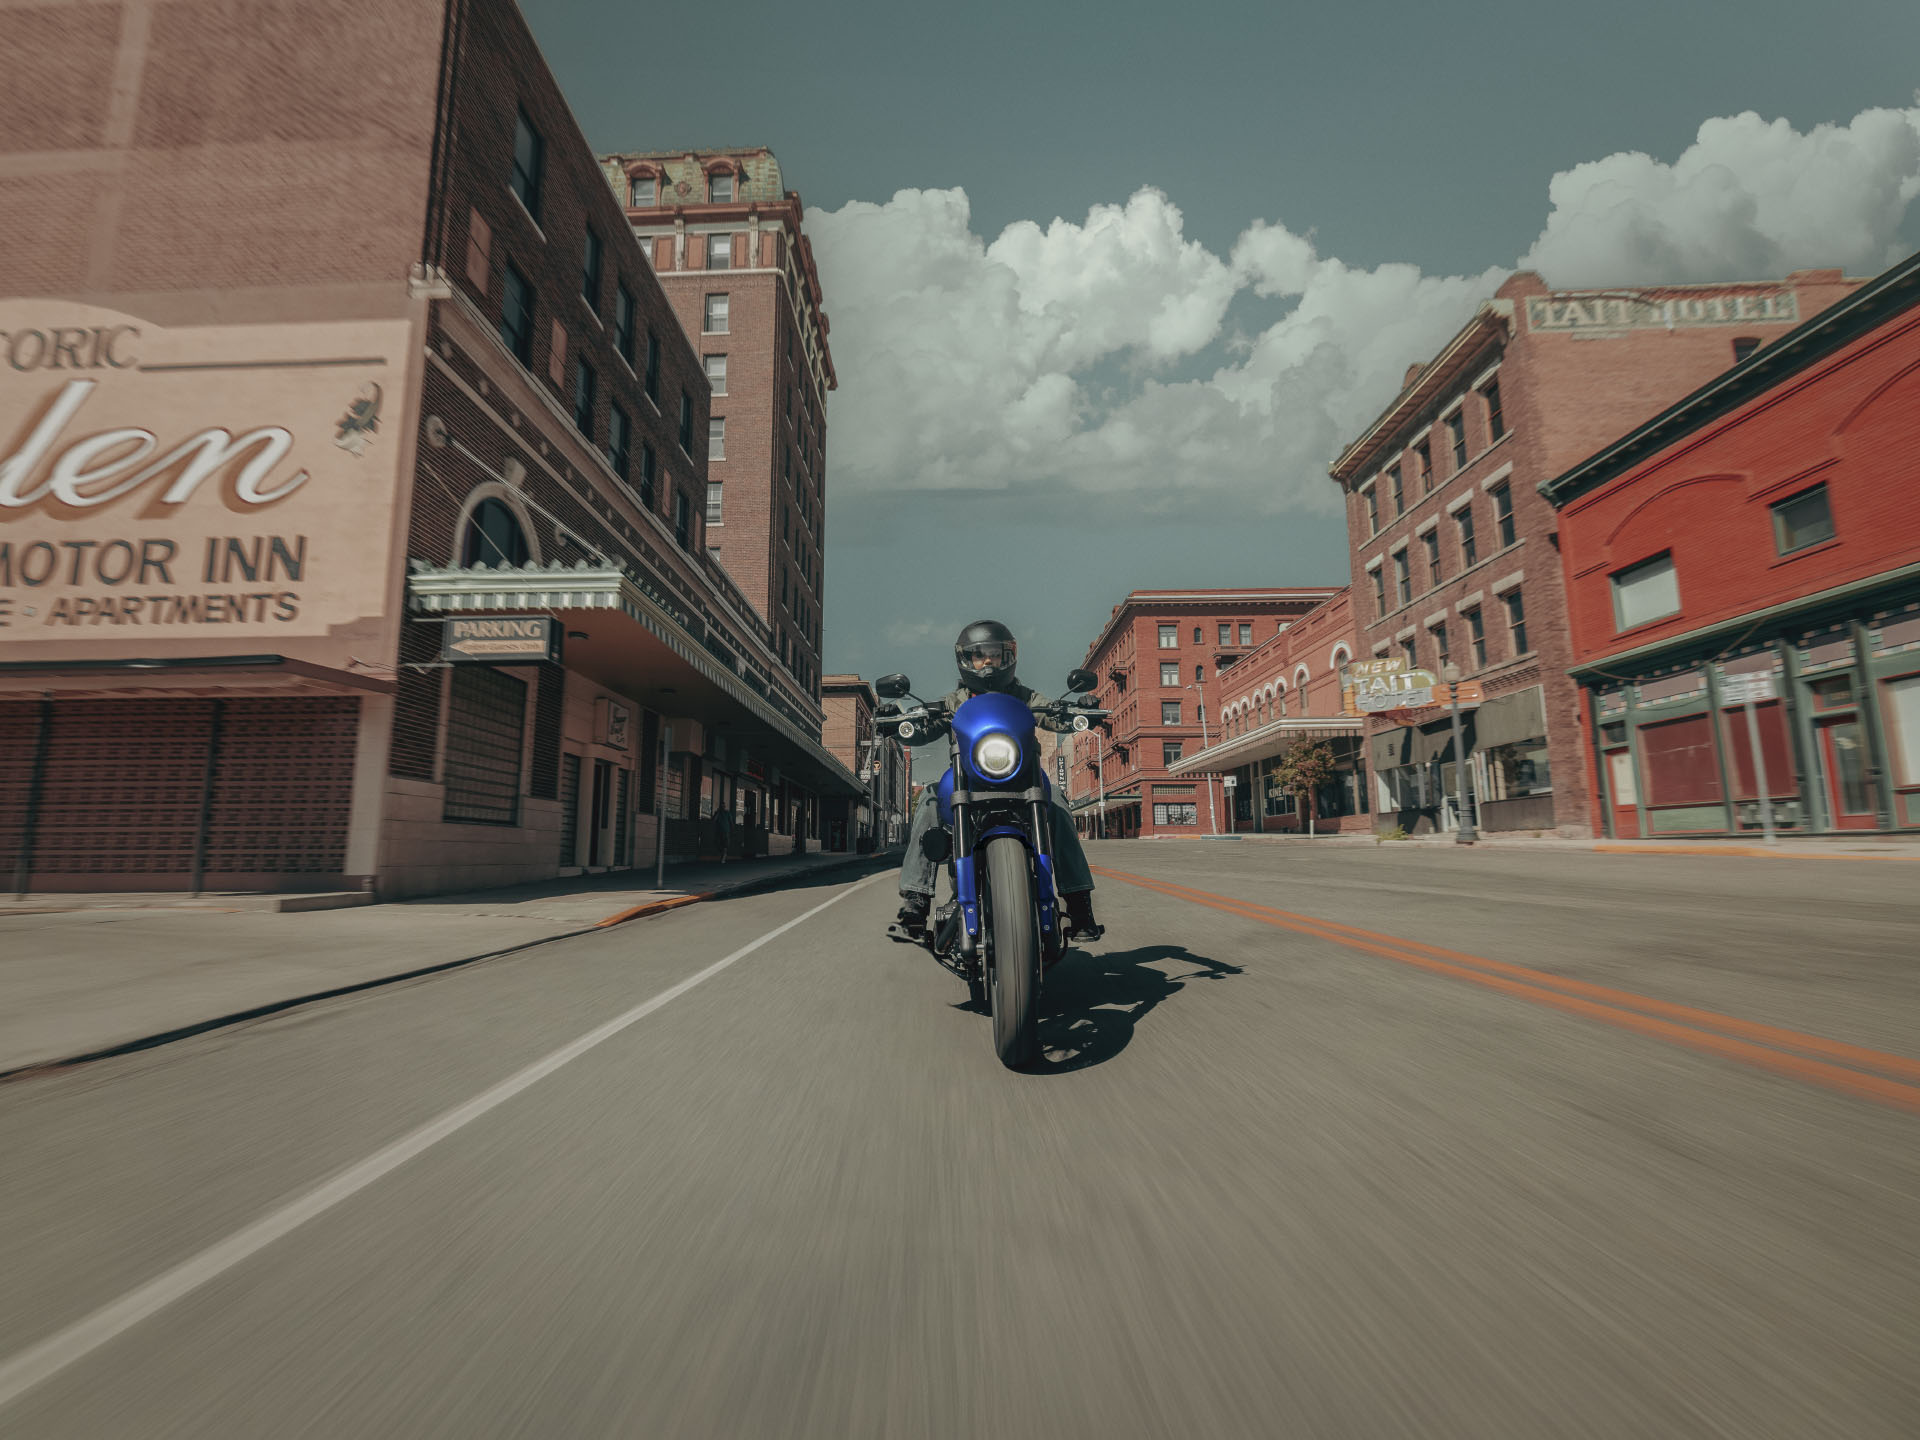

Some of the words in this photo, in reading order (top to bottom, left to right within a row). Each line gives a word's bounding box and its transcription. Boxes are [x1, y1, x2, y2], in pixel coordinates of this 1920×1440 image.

[1535, 298, 1633, 328] TAIT
[0, 325, 141, 372] ORIC
[202, 535, 307, 585] INN
[43, 592, 301, 626] APARTMENTS
[453, 620, 542, 638] PARKING
[1354, 661, 1401, 675] NEW
[1353, 672, 1417, 697] TAIT
